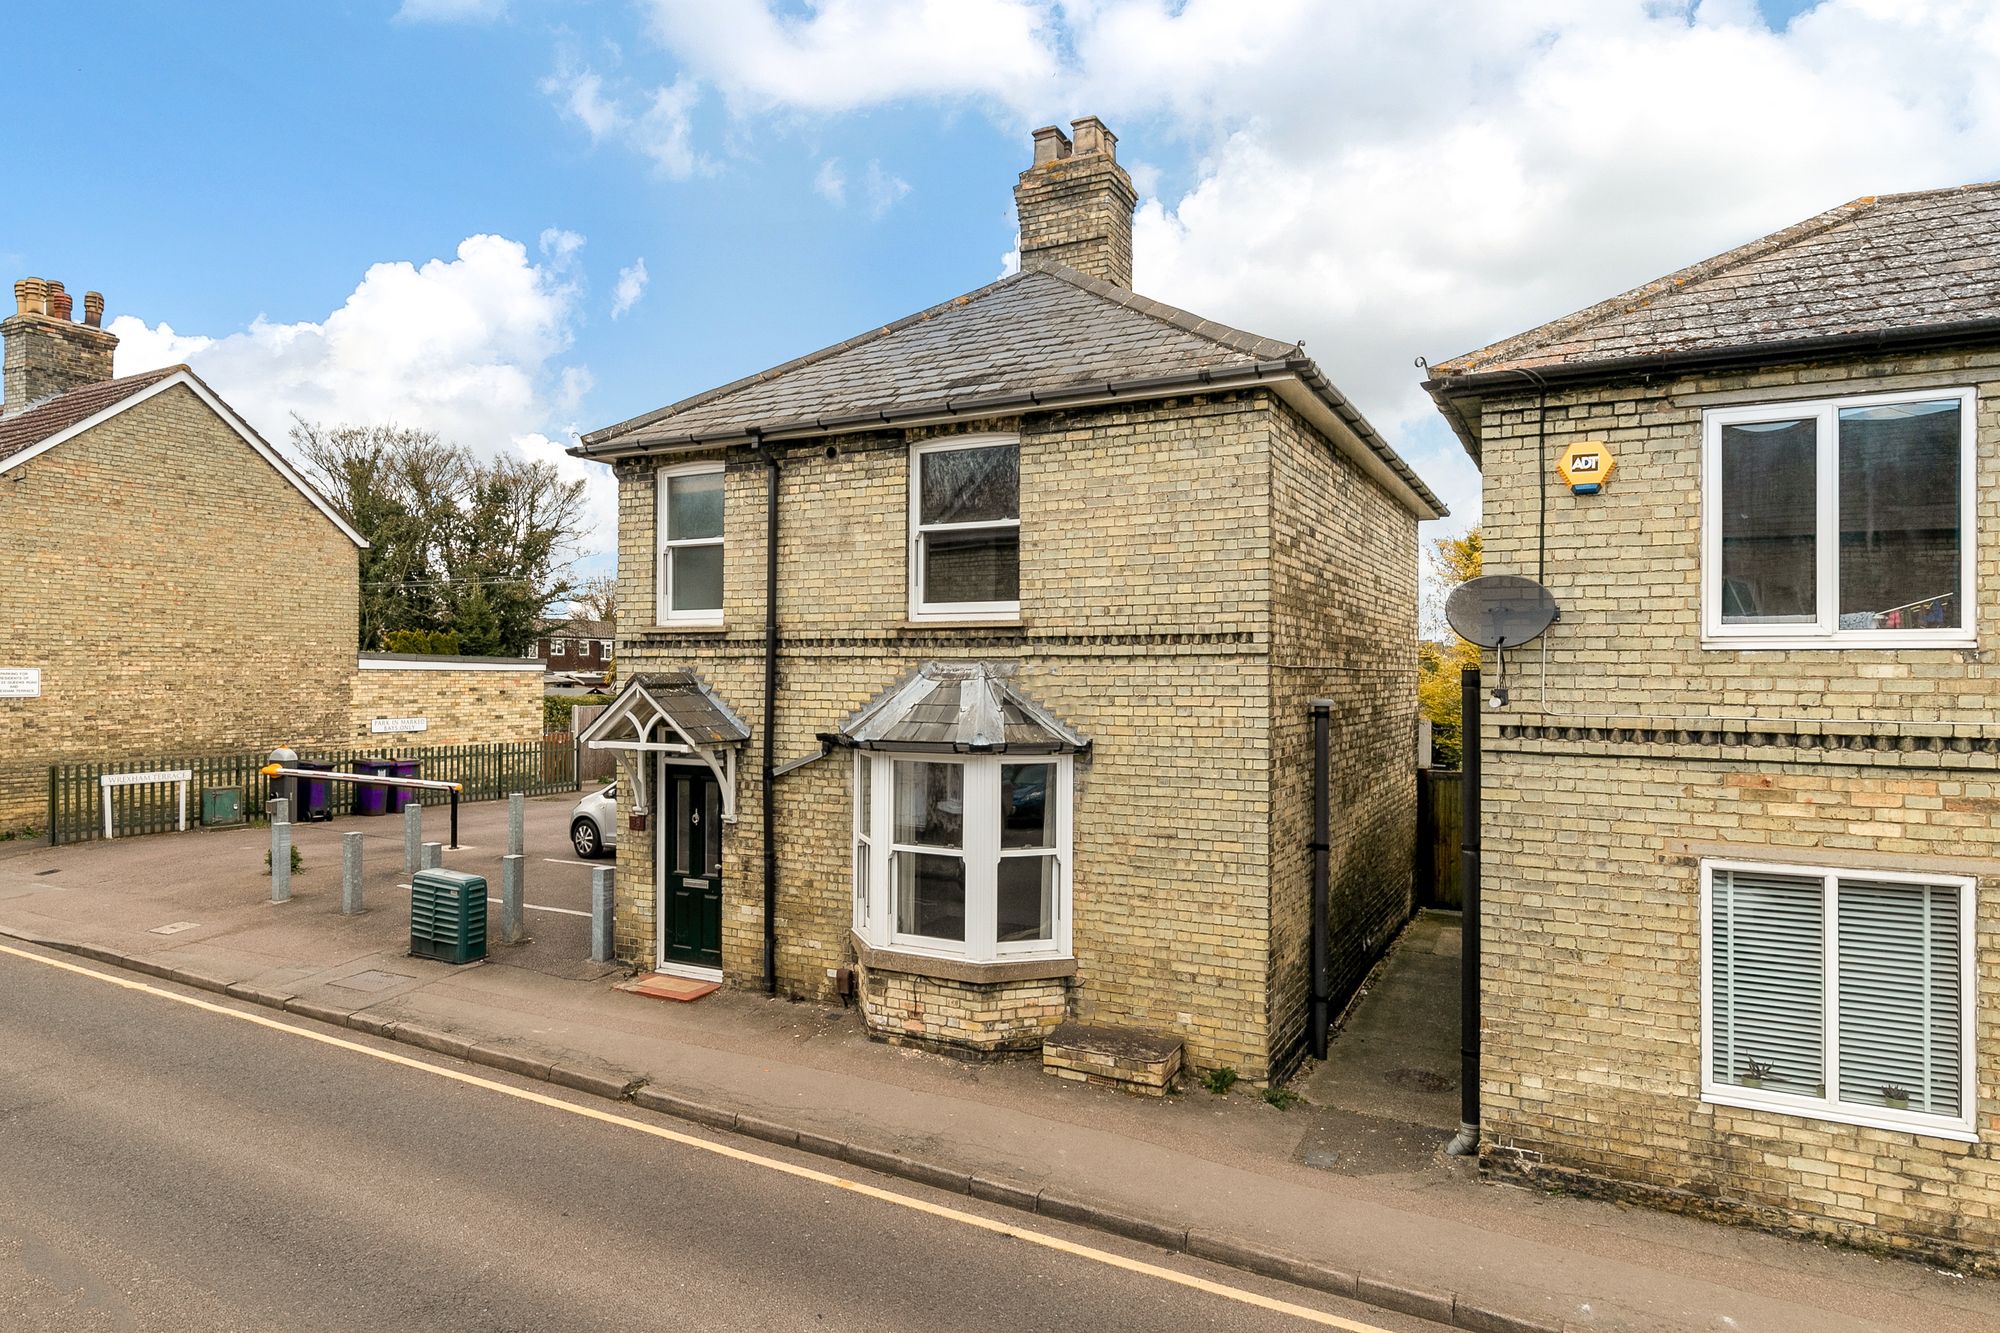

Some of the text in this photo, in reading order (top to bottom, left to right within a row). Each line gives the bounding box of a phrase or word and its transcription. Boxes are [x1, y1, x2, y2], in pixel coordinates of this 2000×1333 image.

[1571, 455, 1599, 470] ADT
[108, 773, 186, 783] WREXHAM TERRACE
